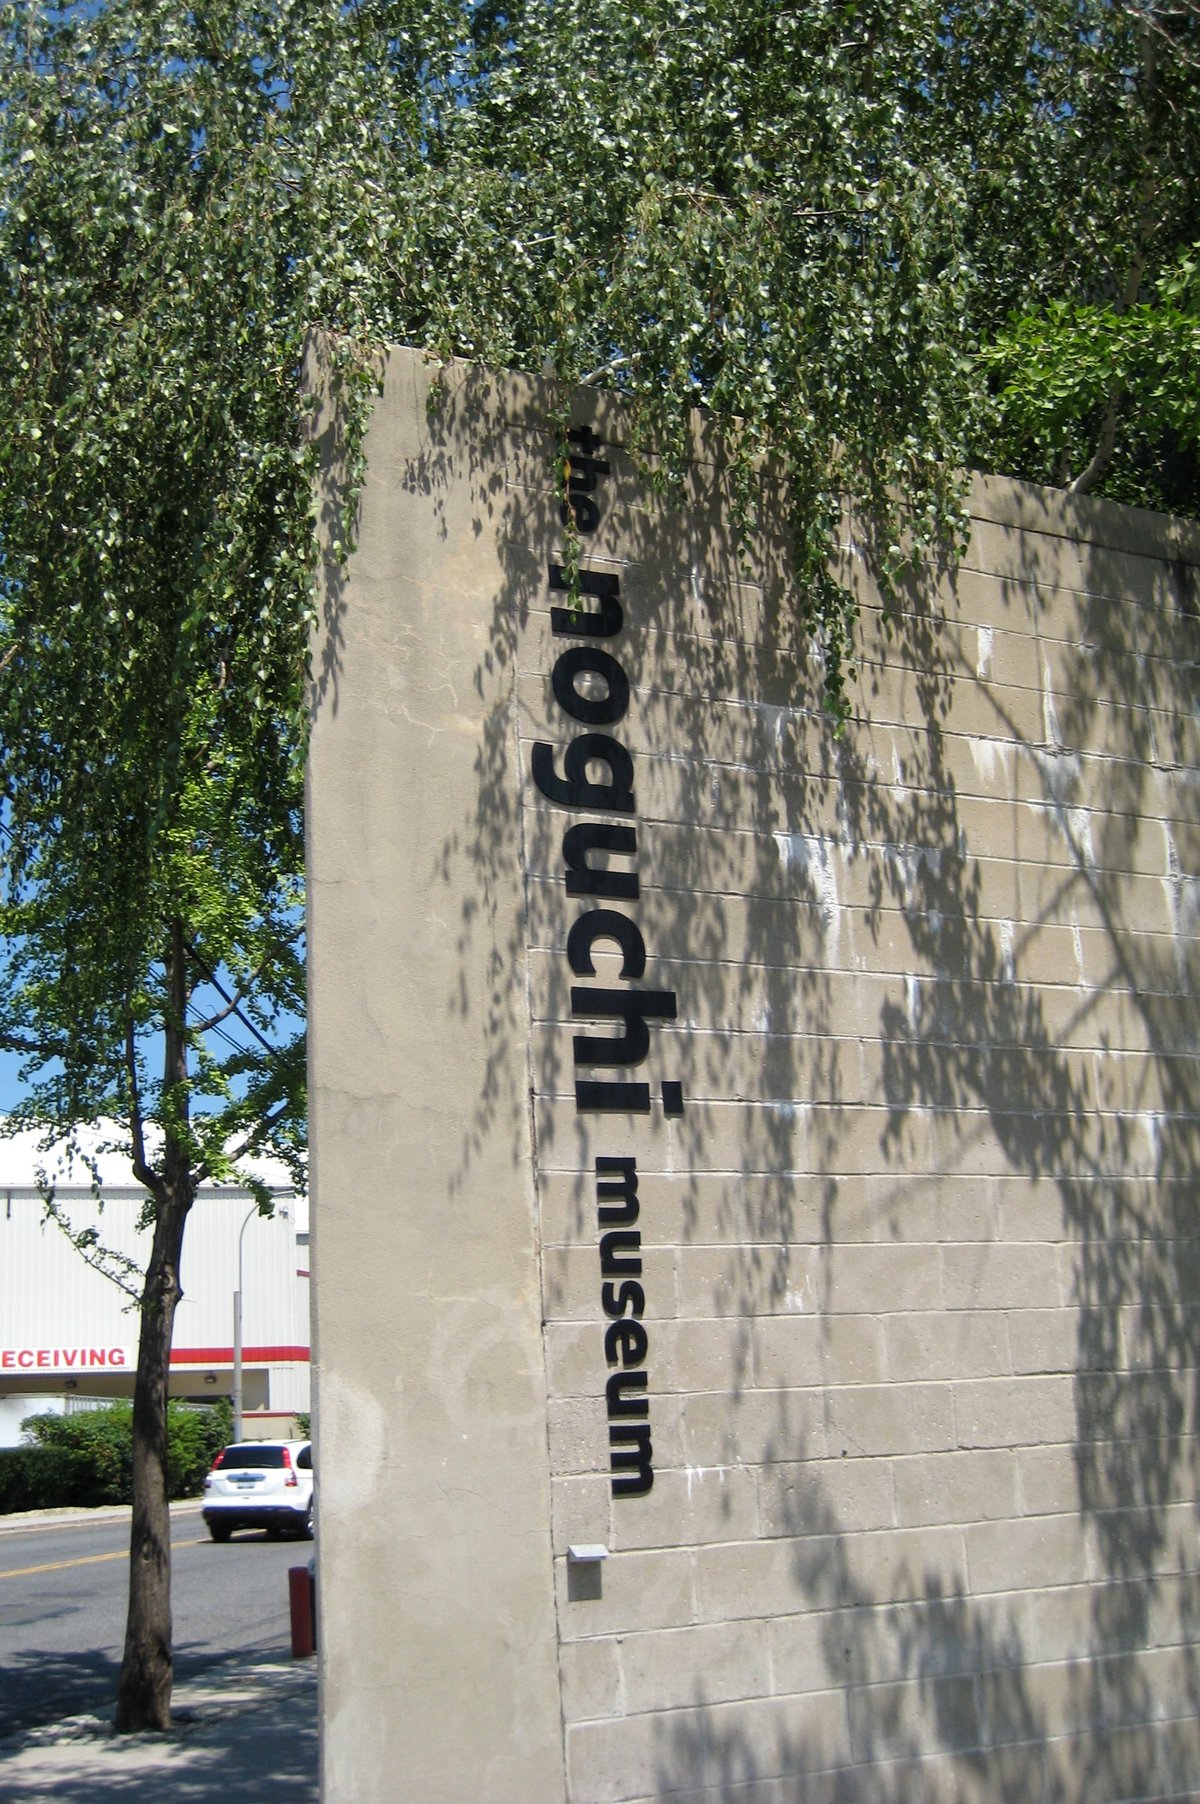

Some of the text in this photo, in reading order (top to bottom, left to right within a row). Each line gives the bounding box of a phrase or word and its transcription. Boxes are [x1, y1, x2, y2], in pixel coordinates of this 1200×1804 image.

[531, 426, 685, 1499] the noguchi museum
[1, 1347, 126, 1368] ECEIVING
